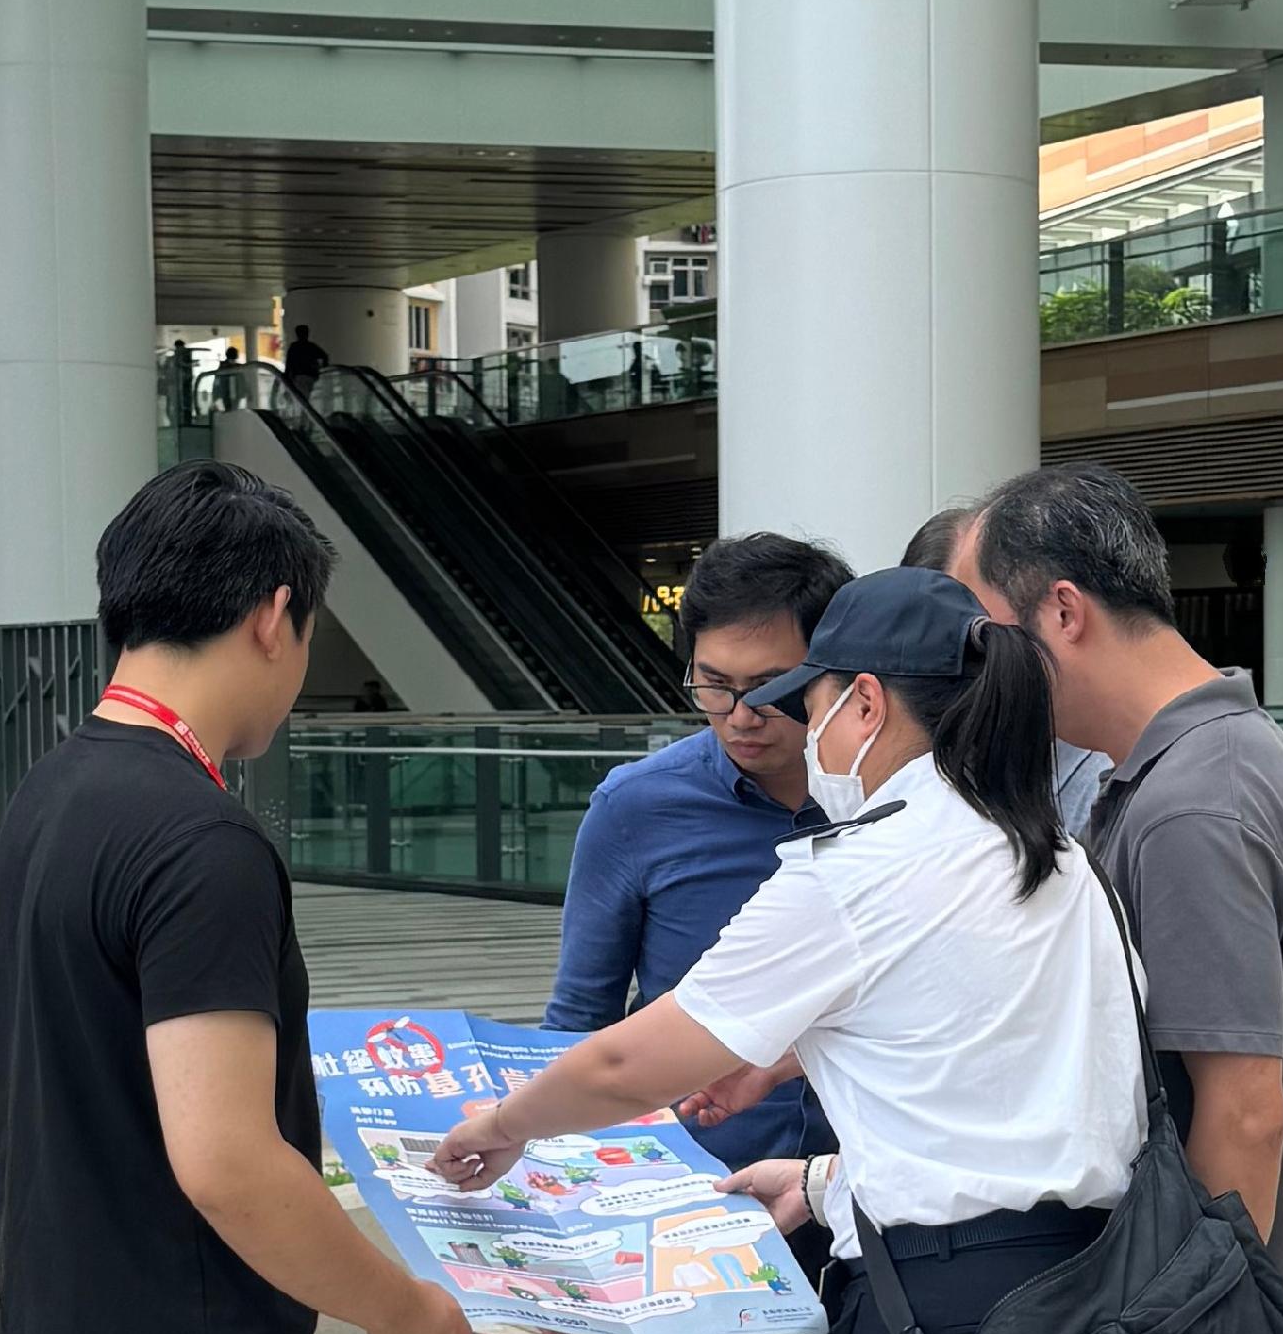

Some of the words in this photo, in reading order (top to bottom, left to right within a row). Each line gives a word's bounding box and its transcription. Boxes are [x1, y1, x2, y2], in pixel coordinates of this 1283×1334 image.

[358, 1062, 544, 1099] 預防基孔肯
